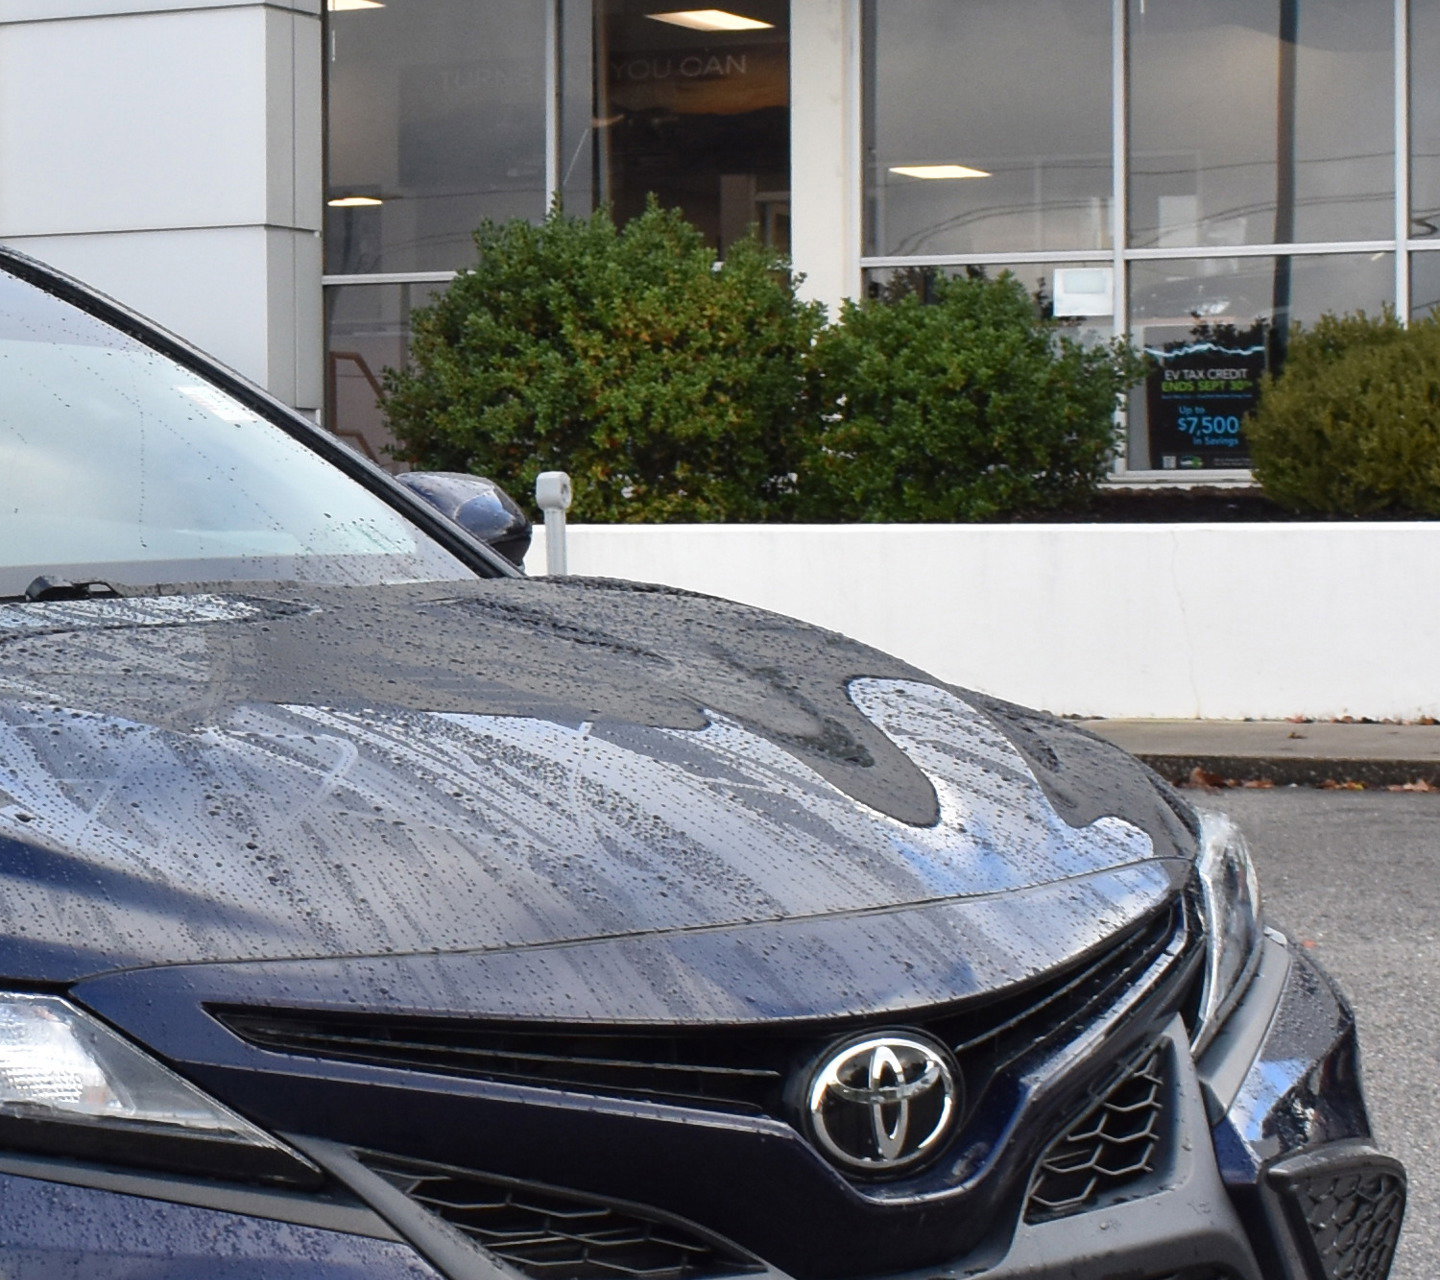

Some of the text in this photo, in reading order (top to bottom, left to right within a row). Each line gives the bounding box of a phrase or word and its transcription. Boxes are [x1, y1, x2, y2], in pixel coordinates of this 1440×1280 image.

[611, 58, 672, 81] YOU
[679, 54, 748, 78] CAN
[1164, 368, 1248, 380] EV TAX CREDIT
[1161, 380, 1195, 392] ENDS
[1198, 380, 1226, 391] SEPT
[1178, 416, 1239, 436] $7,500
